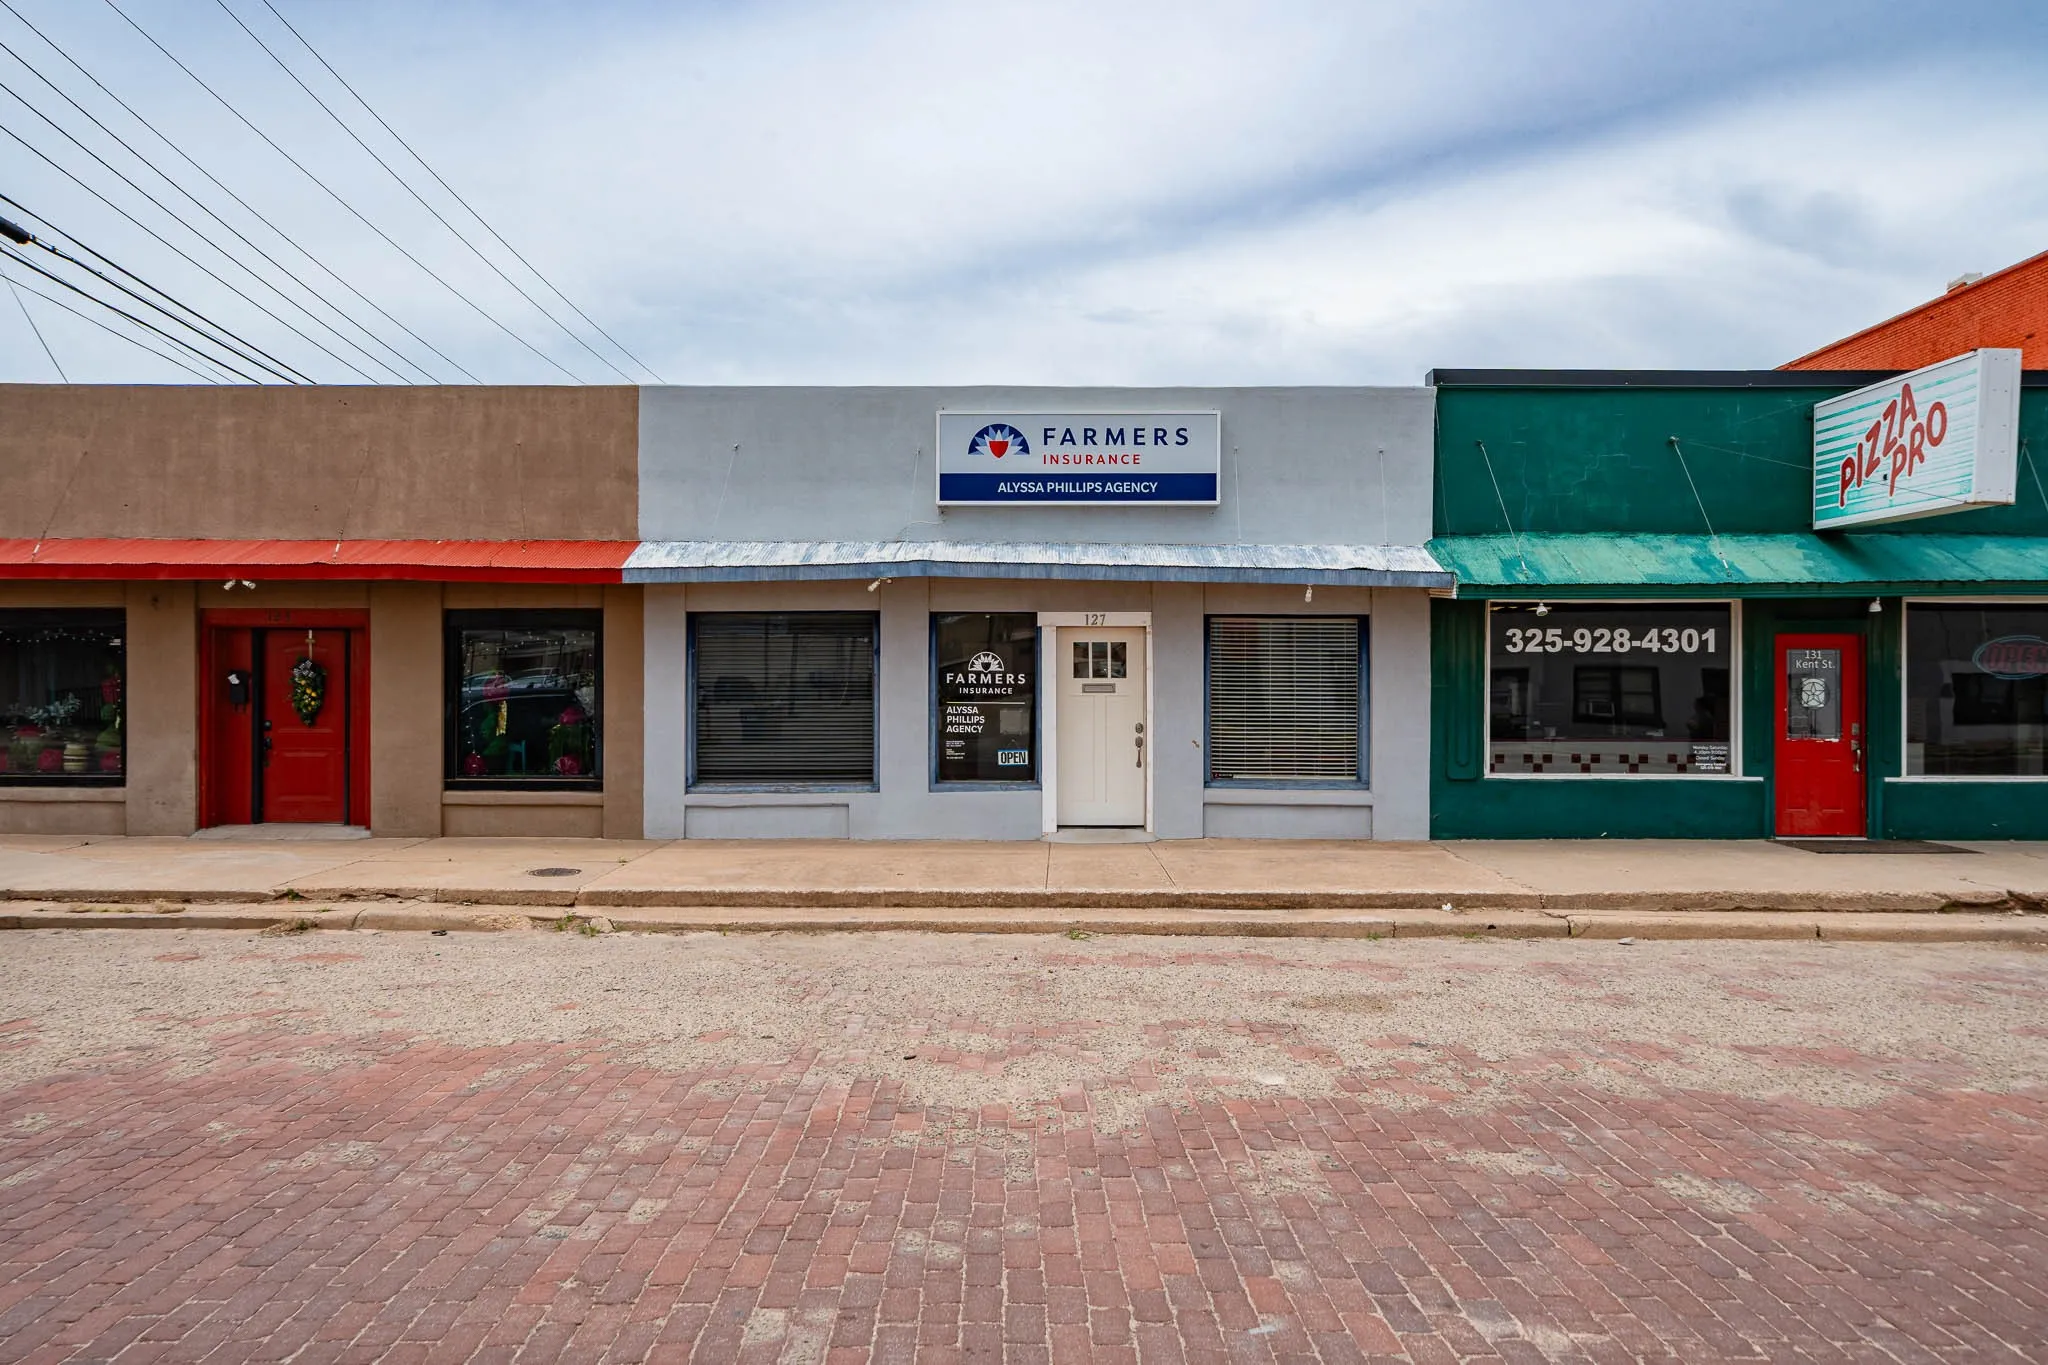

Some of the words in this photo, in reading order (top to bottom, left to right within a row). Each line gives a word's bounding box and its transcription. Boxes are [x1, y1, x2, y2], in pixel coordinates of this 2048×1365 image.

[1043, 427, 1190, 446] FARMERS
[1839, 383, 1918, 508] PIZZA
[1889, 401, 1948, 497] PRO
[1043, 454, 1141, 465] INSURANCE
[997, 482, 1044, 493] ALYSSA
[1047, 482, 1102, 493] PHILLIPS
[1104, 482, 1158, 493] AGENCY
[1085, 613, 1106, 626] 127
[1505, 628, 1716, 654] 325-928-4301
[1804, 650, 1822, 659] 131
[1795, 660, 1819, 669] Kent
[1822, 660, 1835, 669] St.
[946, 673, 1026, 684] FARMERS
[959, 687, 1013, 695] INSURANCE
[946, 706, 979, 714] ALYSSA
[946, 725, 984, 733] AGENCY
[1000, 752, 1026, 764] OPEN
